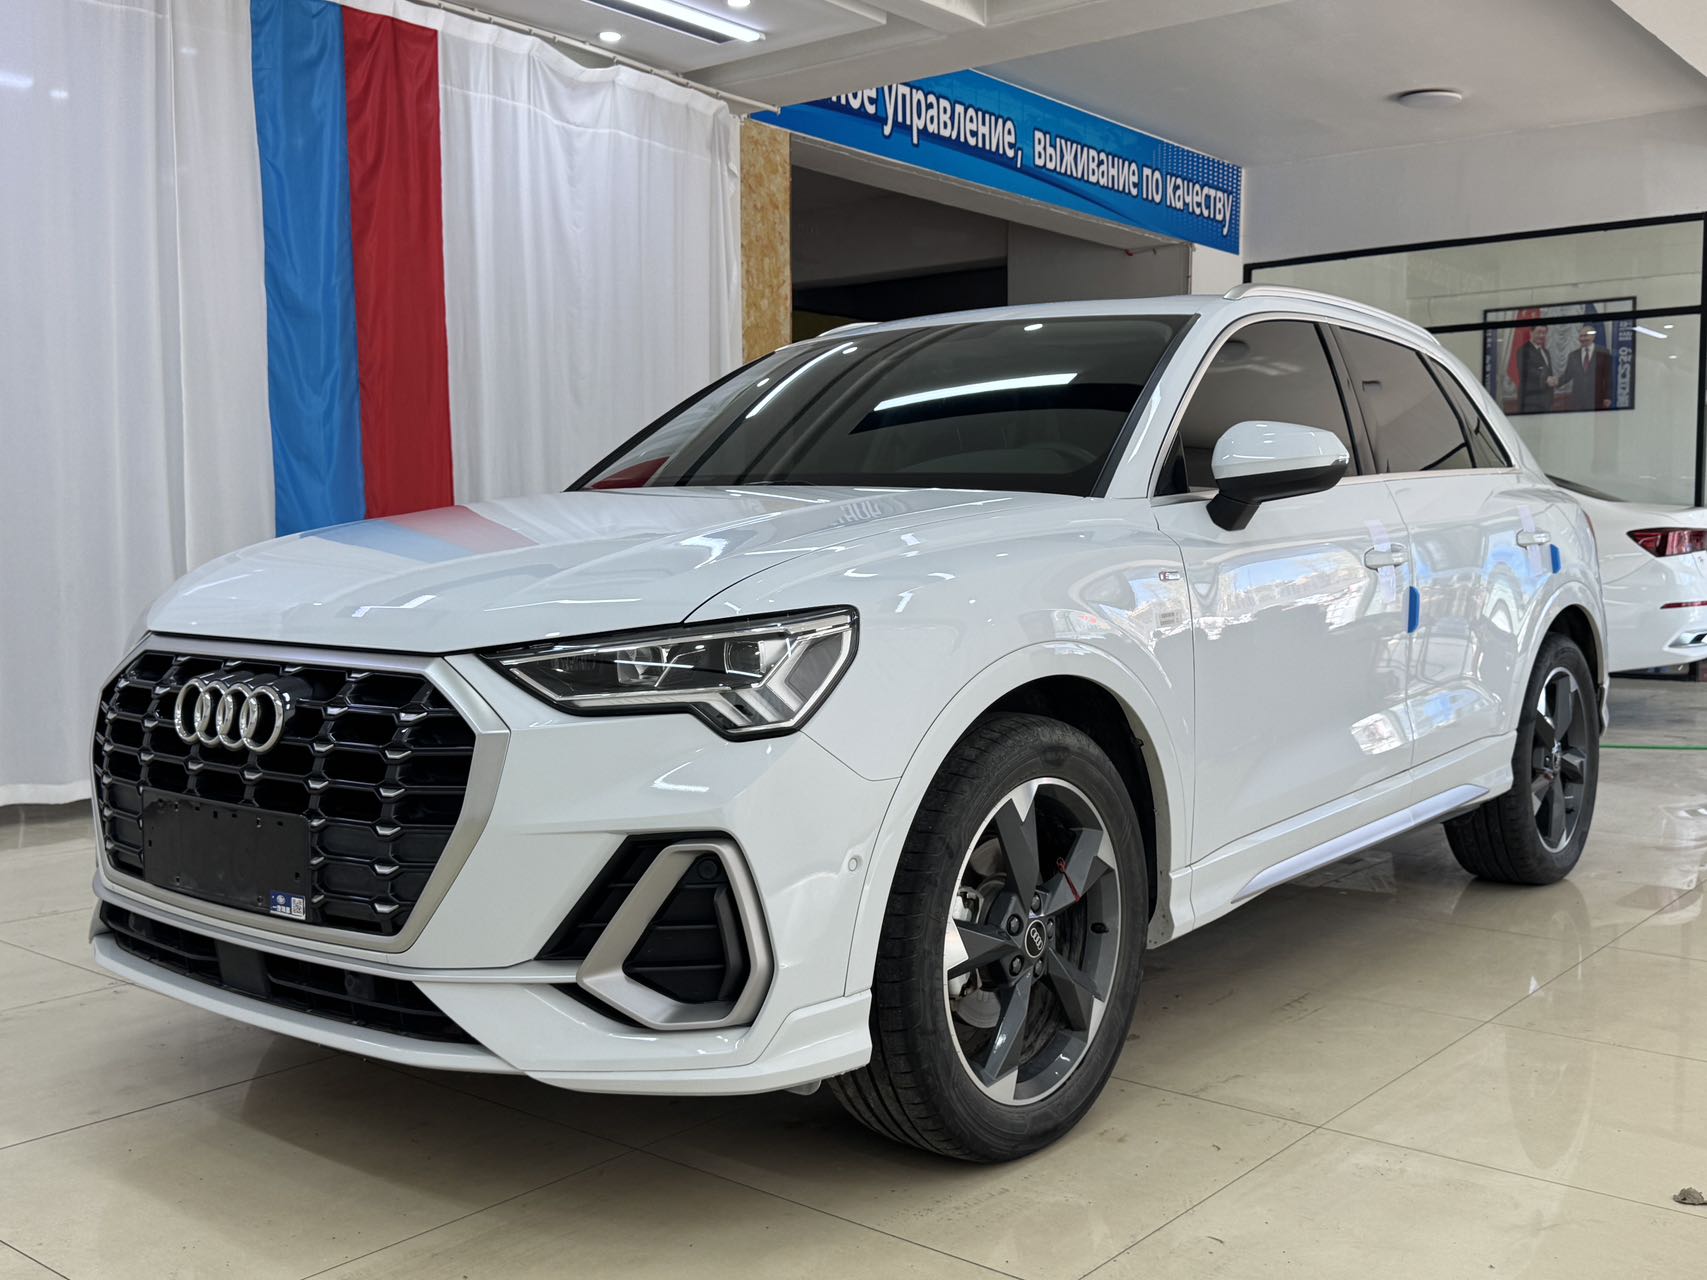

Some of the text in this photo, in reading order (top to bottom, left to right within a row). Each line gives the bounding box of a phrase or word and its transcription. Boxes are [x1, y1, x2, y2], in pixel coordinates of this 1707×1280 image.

[883, 83, 1023, 168] управление,
[1034, 129, 1139, 198] выживание
[1142, 165, 1163, 204] по
[1166, 174, 1233, 236] качеству
